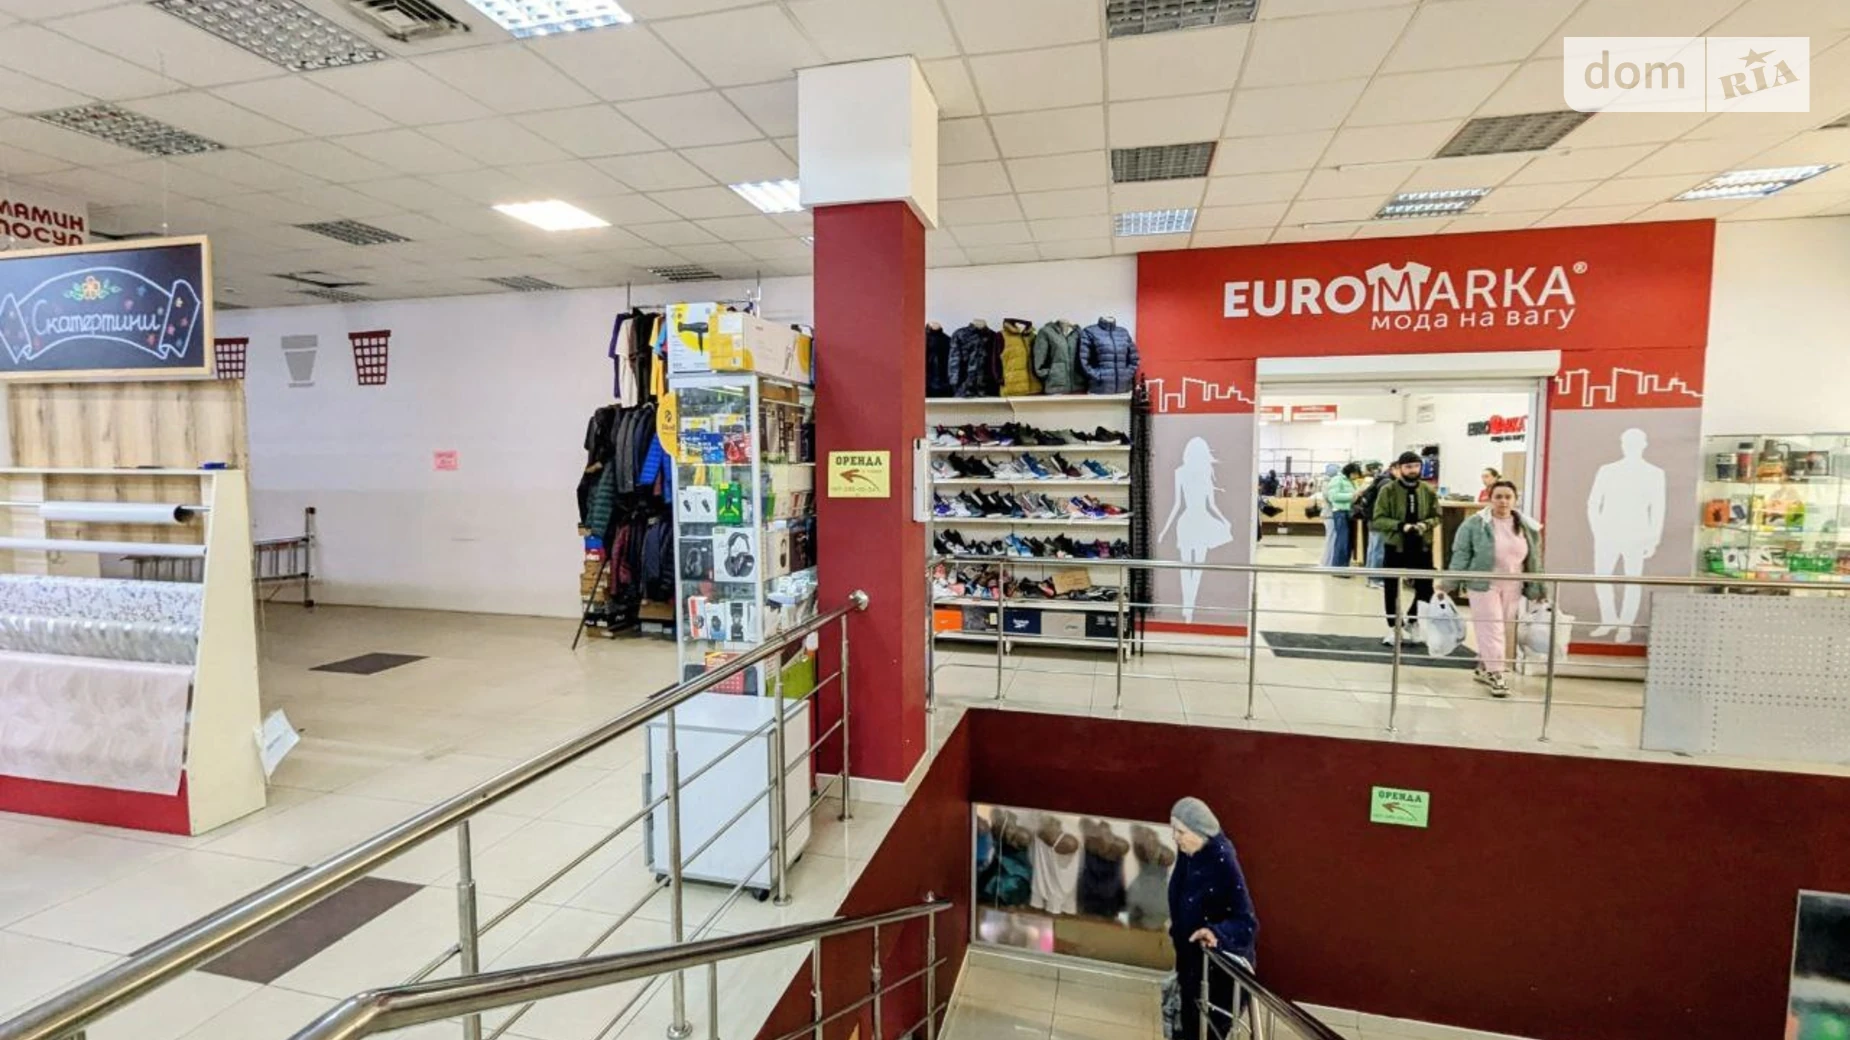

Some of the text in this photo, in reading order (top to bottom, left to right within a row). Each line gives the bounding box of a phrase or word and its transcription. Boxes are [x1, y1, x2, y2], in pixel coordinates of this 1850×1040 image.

[32, 299, 162, 335] Скатертини
[1372, 307, 1576, 331] мода на вагу
[836, 456, 882, 466] ОРЕНДА
[1378, 790, 1422, 803] ОРЕНДА
